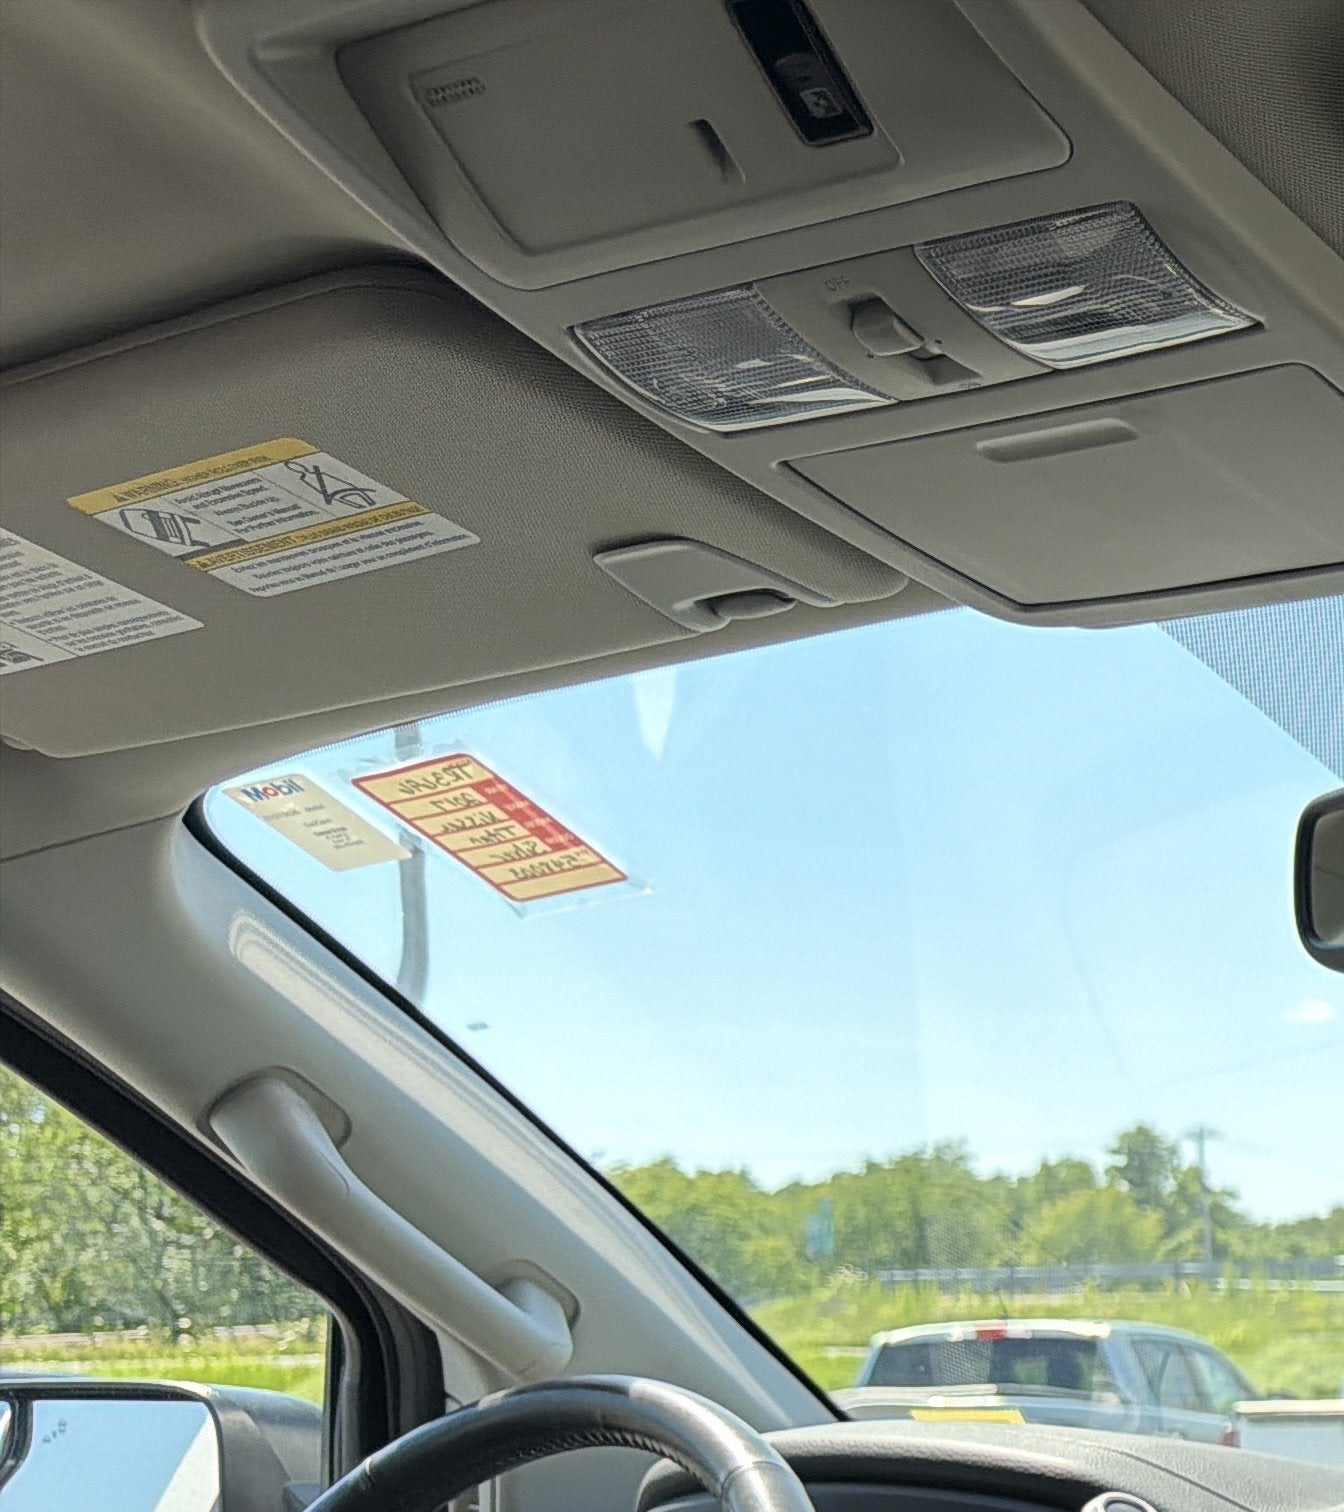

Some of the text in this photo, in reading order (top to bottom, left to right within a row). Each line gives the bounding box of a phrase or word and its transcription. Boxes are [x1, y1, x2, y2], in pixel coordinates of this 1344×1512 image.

[124, 477, 179, 499] WARNING
[206, 536, 296, 567] AVERTISSEMENT
[240, 778, 305, 802] Mobil
